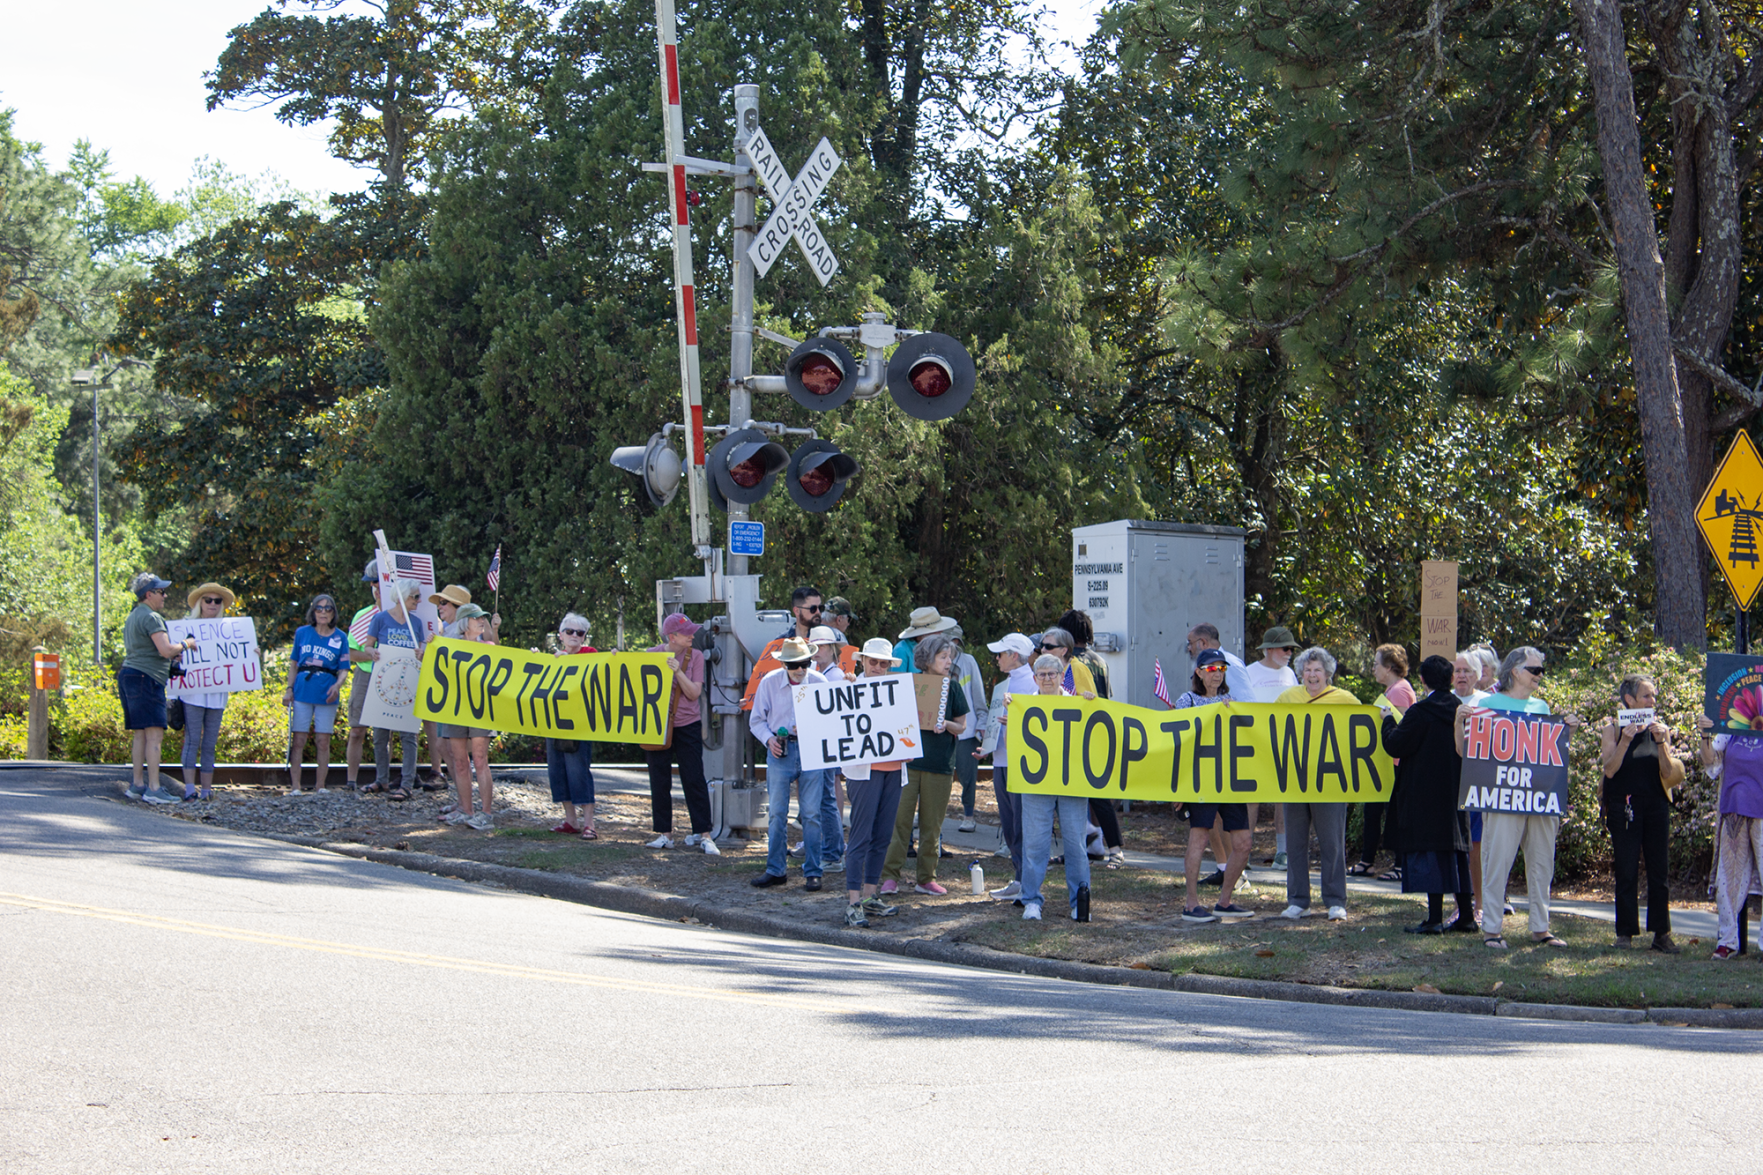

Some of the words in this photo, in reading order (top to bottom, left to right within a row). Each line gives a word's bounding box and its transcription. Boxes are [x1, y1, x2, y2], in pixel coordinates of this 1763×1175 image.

[750, 136, 783, 196] RAIL
[758, 152, 832, 263] CROSSING
[797, 217, 833, 276] ROAD
[1075, 563, 1112, 575] PENNSYLVANIA
[1113, 563, 1123, 574] AVE
[1424, 569, 1451, 589] STOP
[1430, 589, 1444, 600] THE
[1426, 618, 1451, 634] WAR
[216, 641, 250, 661] NOT
[301, 644, 312, 655] NO
[312, 645, 336, 662] KINGS
[1426, 637, 1448, 647] NOW!
[242, 662, 256, 683] U
[1717, 667, 1748, 696] INCLUSION
[426, 646, 513, 722] STOP
[516, 662, 579, 730] THE
[580, 662, 663, 736] WAR
[814, 679, 899, 715] UNFIT
[1719, 685, 1738, 719] KINDNESS
[1740, 674, 1762, 686] PEACE
[840, 713, 872, 737] TO
[821, 731, 895, 763] LEAD
[1020, 706, 1148, 792] STOP
[1160, 713, 1258, 794] THE
[1269, 712, 1383, 794] WAR
[1466, 714, 1565, 767] HONK
[1496, 765, 1533, 788] FOR
[1464, 785, 1561, 814] AMERICA
